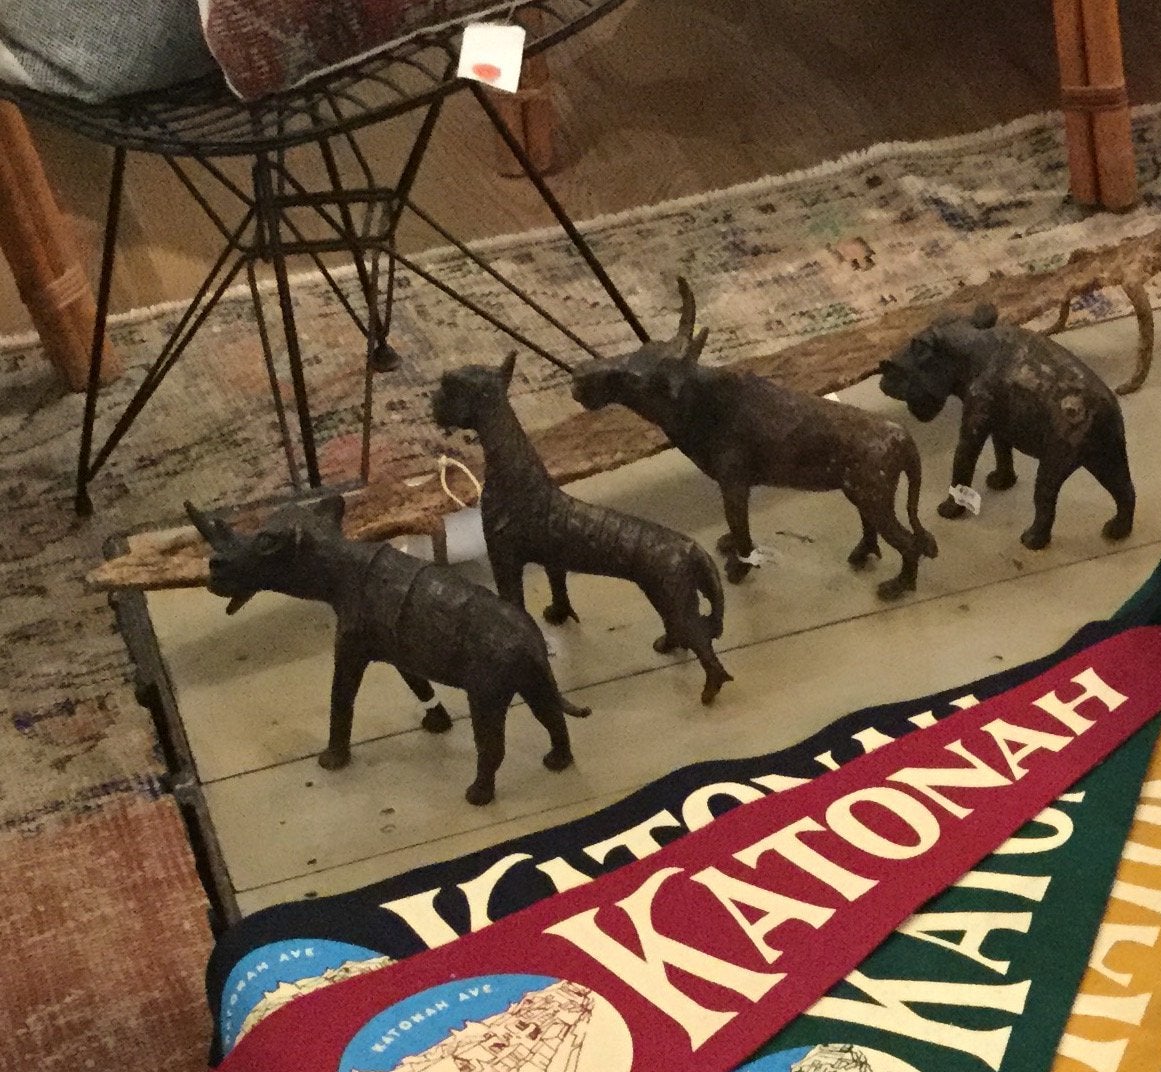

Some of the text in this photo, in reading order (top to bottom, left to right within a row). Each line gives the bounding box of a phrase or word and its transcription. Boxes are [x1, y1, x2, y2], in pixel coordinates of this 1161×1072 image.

[543, 666, 1129, 1052] KATONAH
[371, 983, 493, 1053] KATONAH AVE
